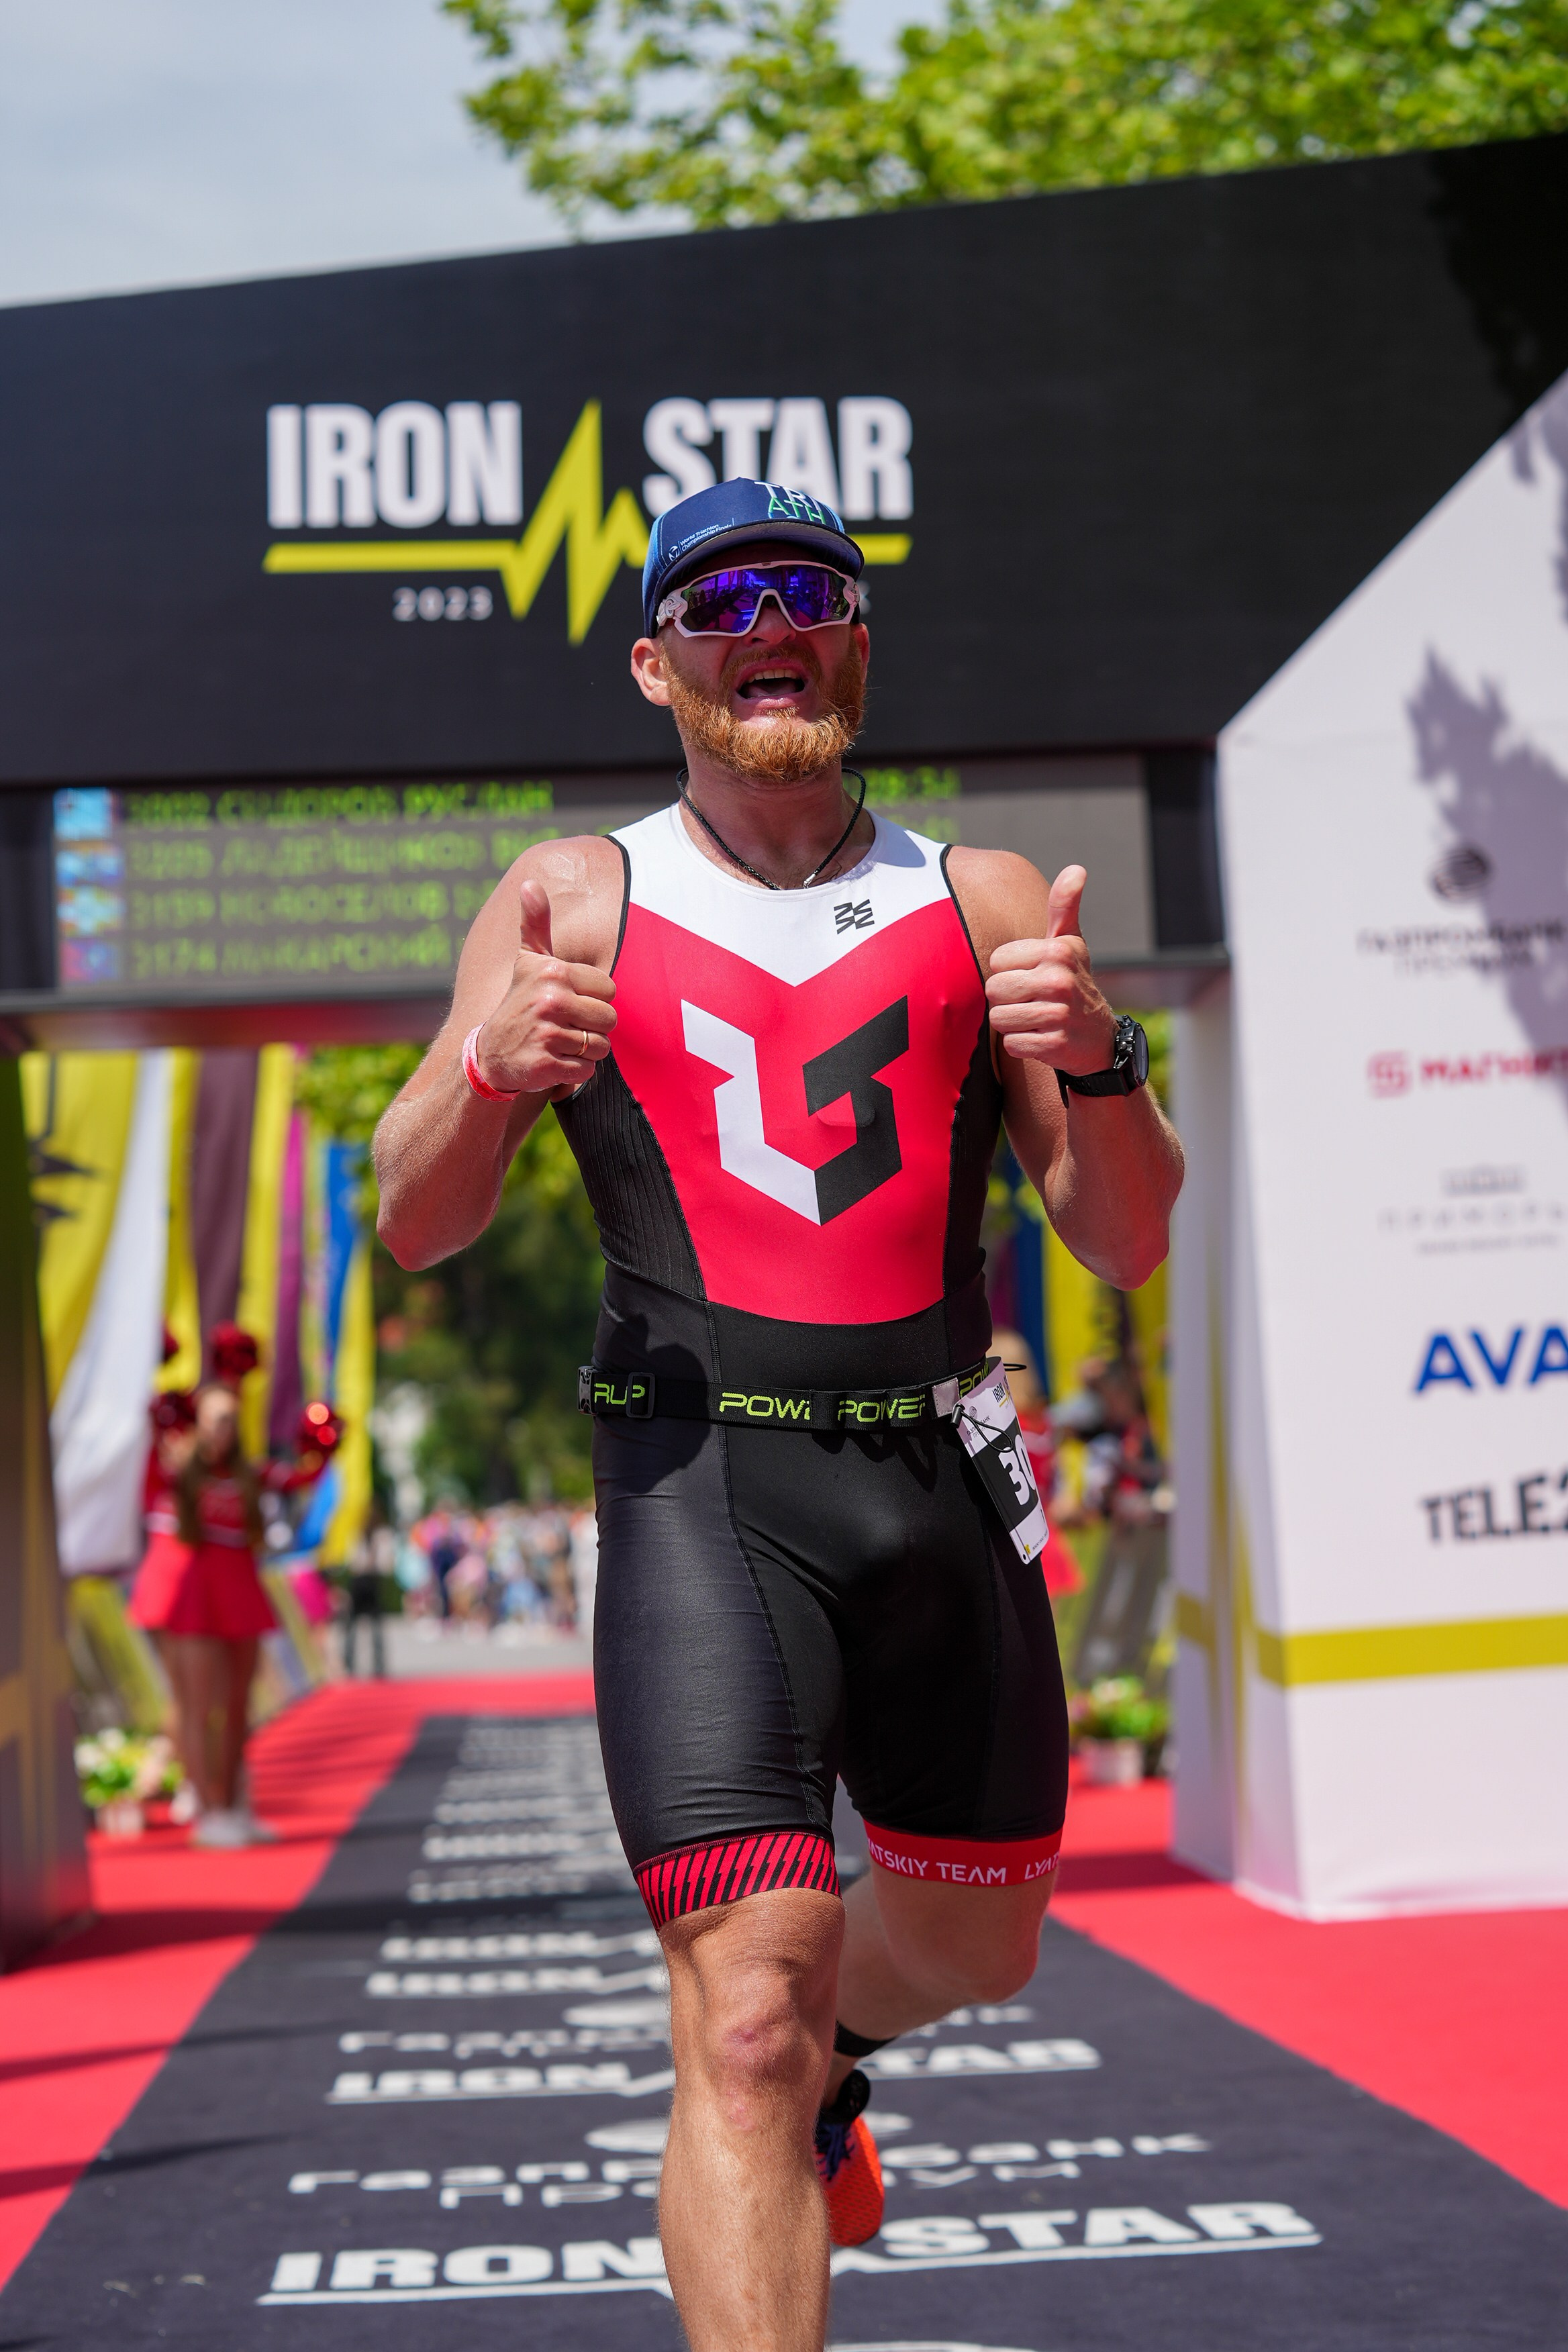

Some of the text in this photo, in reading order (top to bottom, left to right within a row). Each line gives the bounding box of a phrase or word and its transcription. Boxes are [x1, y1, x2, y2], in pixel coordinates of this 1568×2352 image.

[268, 396, 913, 528] IRON STAR
[754, 481, 821, 511] TRI
[768, 497, 826, 524] ATH
[680, 524, 719, 546] World Triathlon
[682, 524, 732, 552] Championship Finals
[392, 585, 493, 622] 2023
[1413, 1324, 1568, 1393] AVA
[992, 1382, 1006, 1403] IRON
[936, 1862, 1006, 1884] TEAM
[856, 2038, 1101, 2075] TAR
[271, 2202, 1316, 2292] IRON STAR
